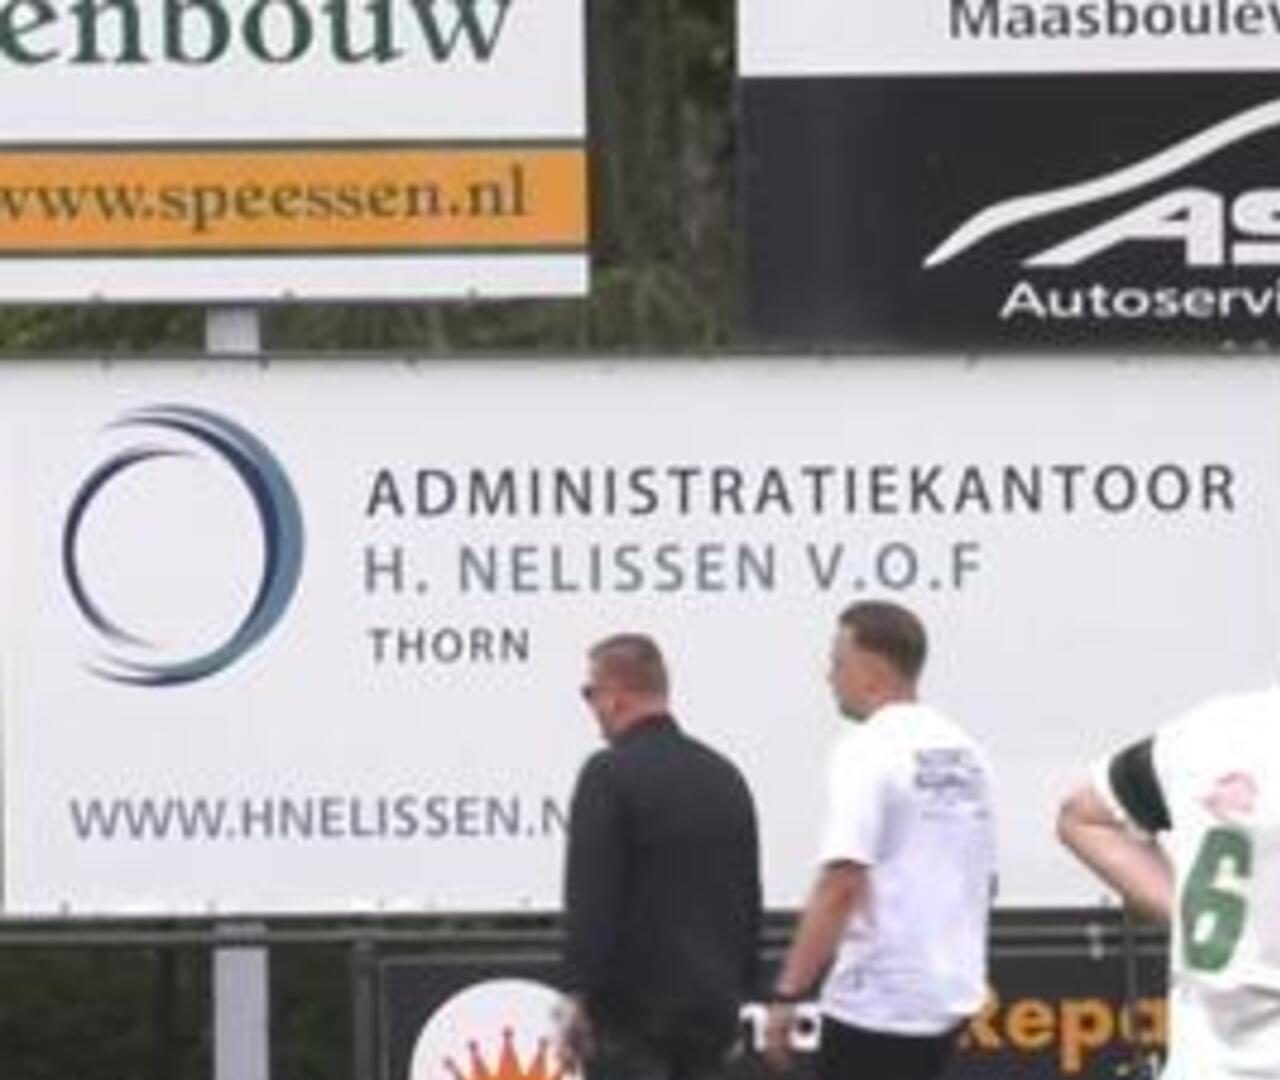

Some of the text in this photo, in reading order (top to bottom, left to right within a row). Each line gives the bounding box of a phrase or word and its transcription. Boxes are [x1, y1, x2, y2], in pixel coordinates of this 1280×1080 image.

[365, 464, 1236, 518] ADMINISTRATIEKANTOOR
[363, 541, 980, 595] H. NELISSEN V.O.F
[370, 626, 531, 664] THORN
[68, 794, 570, 840] WWW.HNELISSEN.N
[1181, 826, 1254, 973] 6
